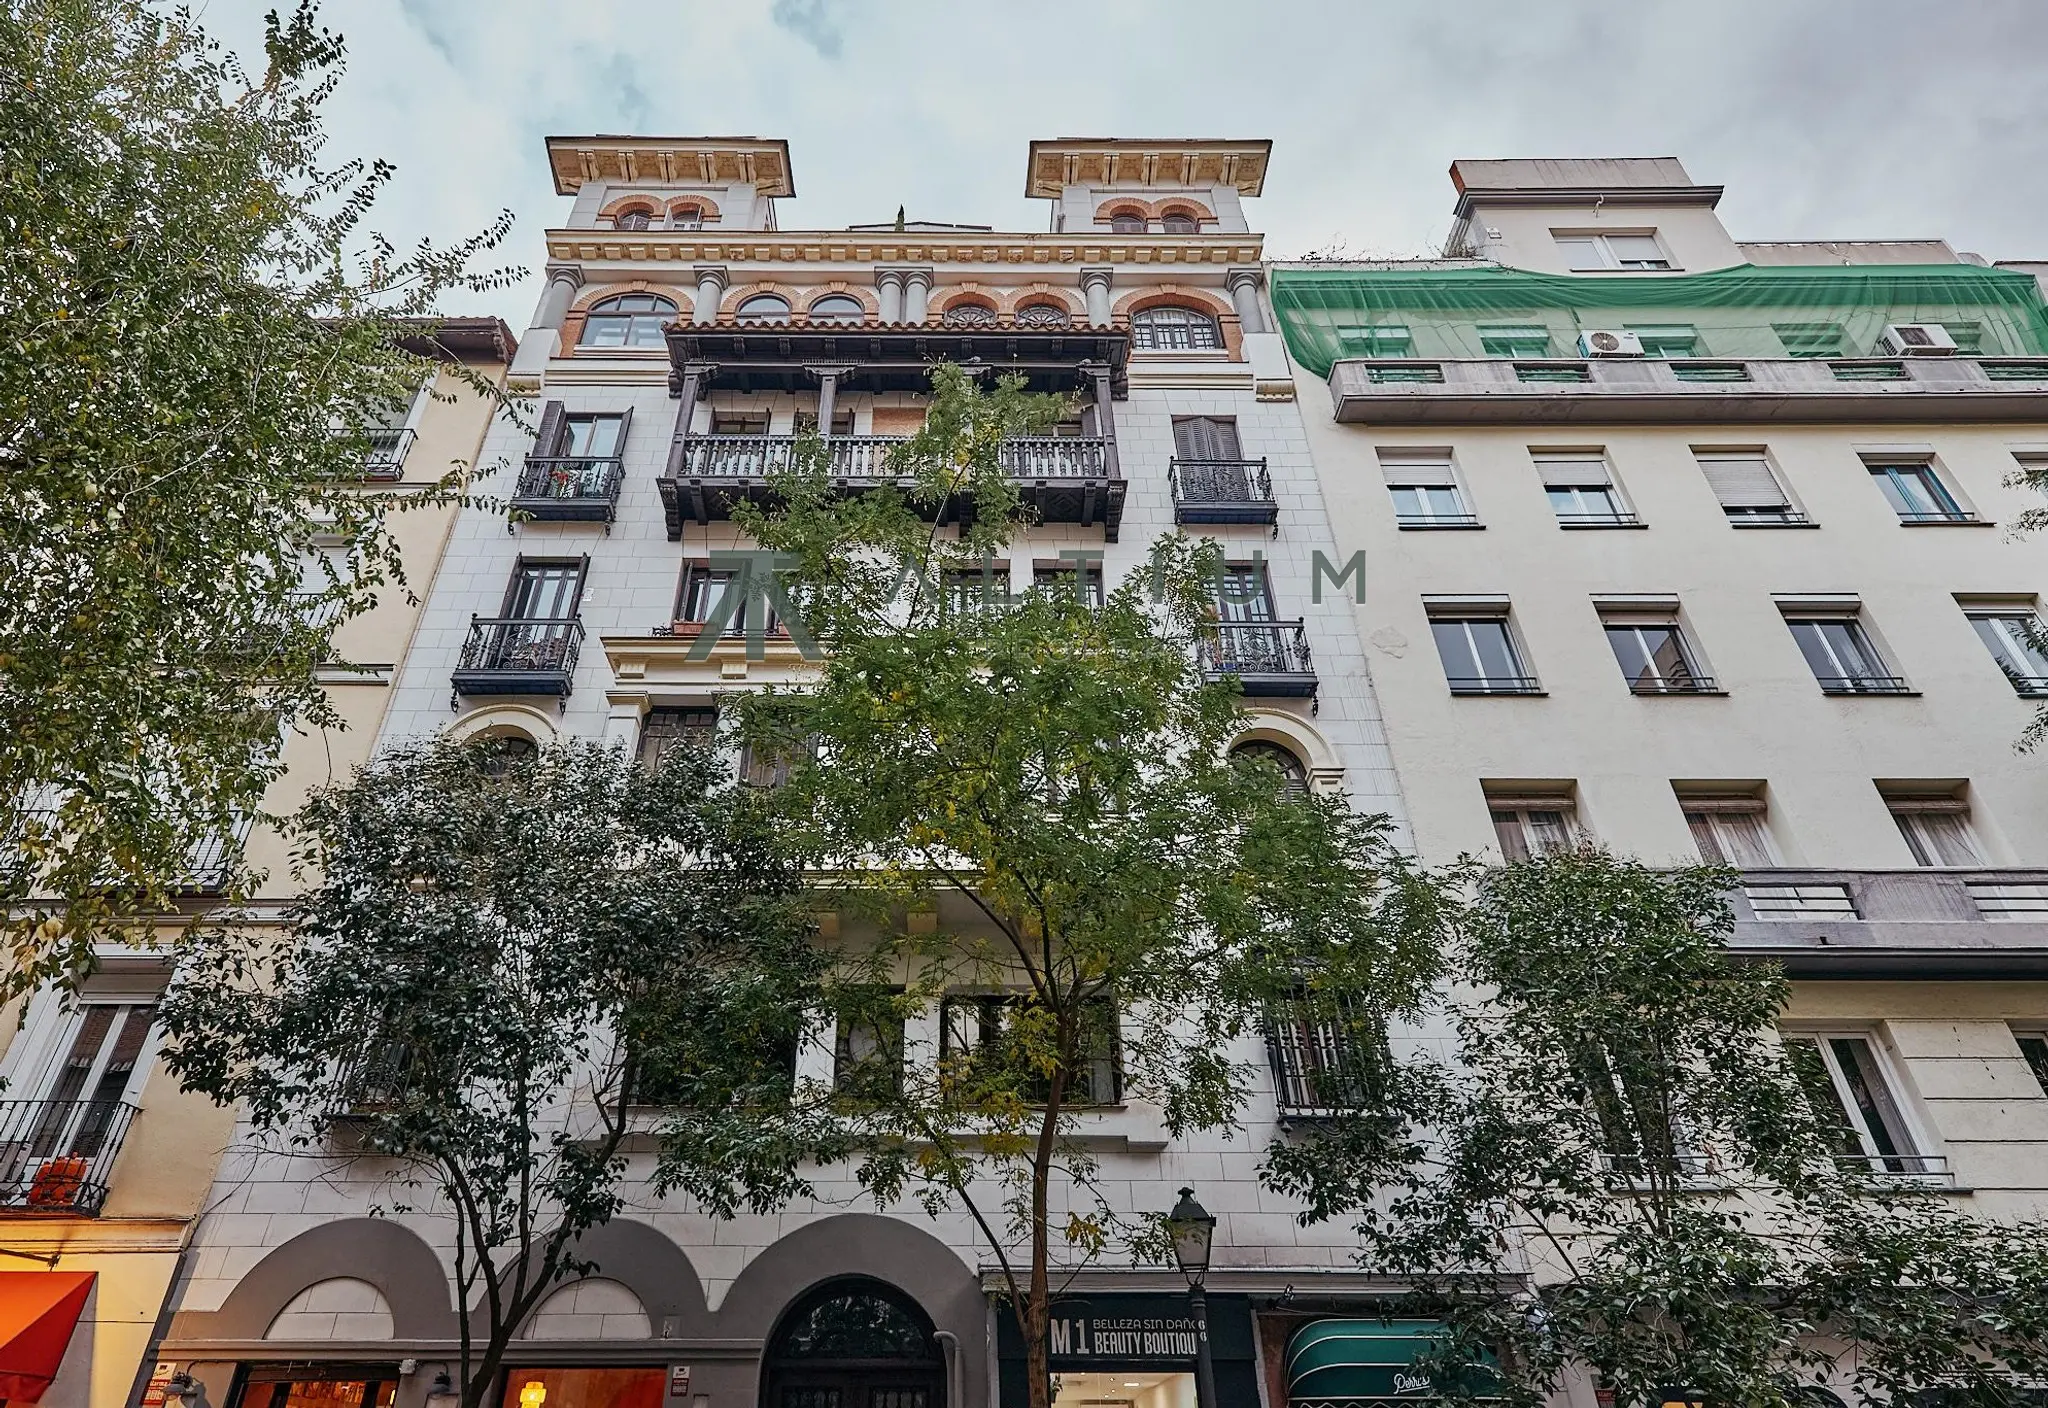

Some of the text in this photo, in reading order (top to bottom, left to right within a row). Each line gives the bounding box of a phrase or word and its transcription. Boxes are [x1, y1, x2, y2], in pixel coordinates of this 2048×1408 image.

[1093, 1319, 1141, 1329] BELLEZA
[1144, 1319, 1163, 1329] SIN
[1094, 1332, 1197, 1354] BEAUTY BOUTIQU
